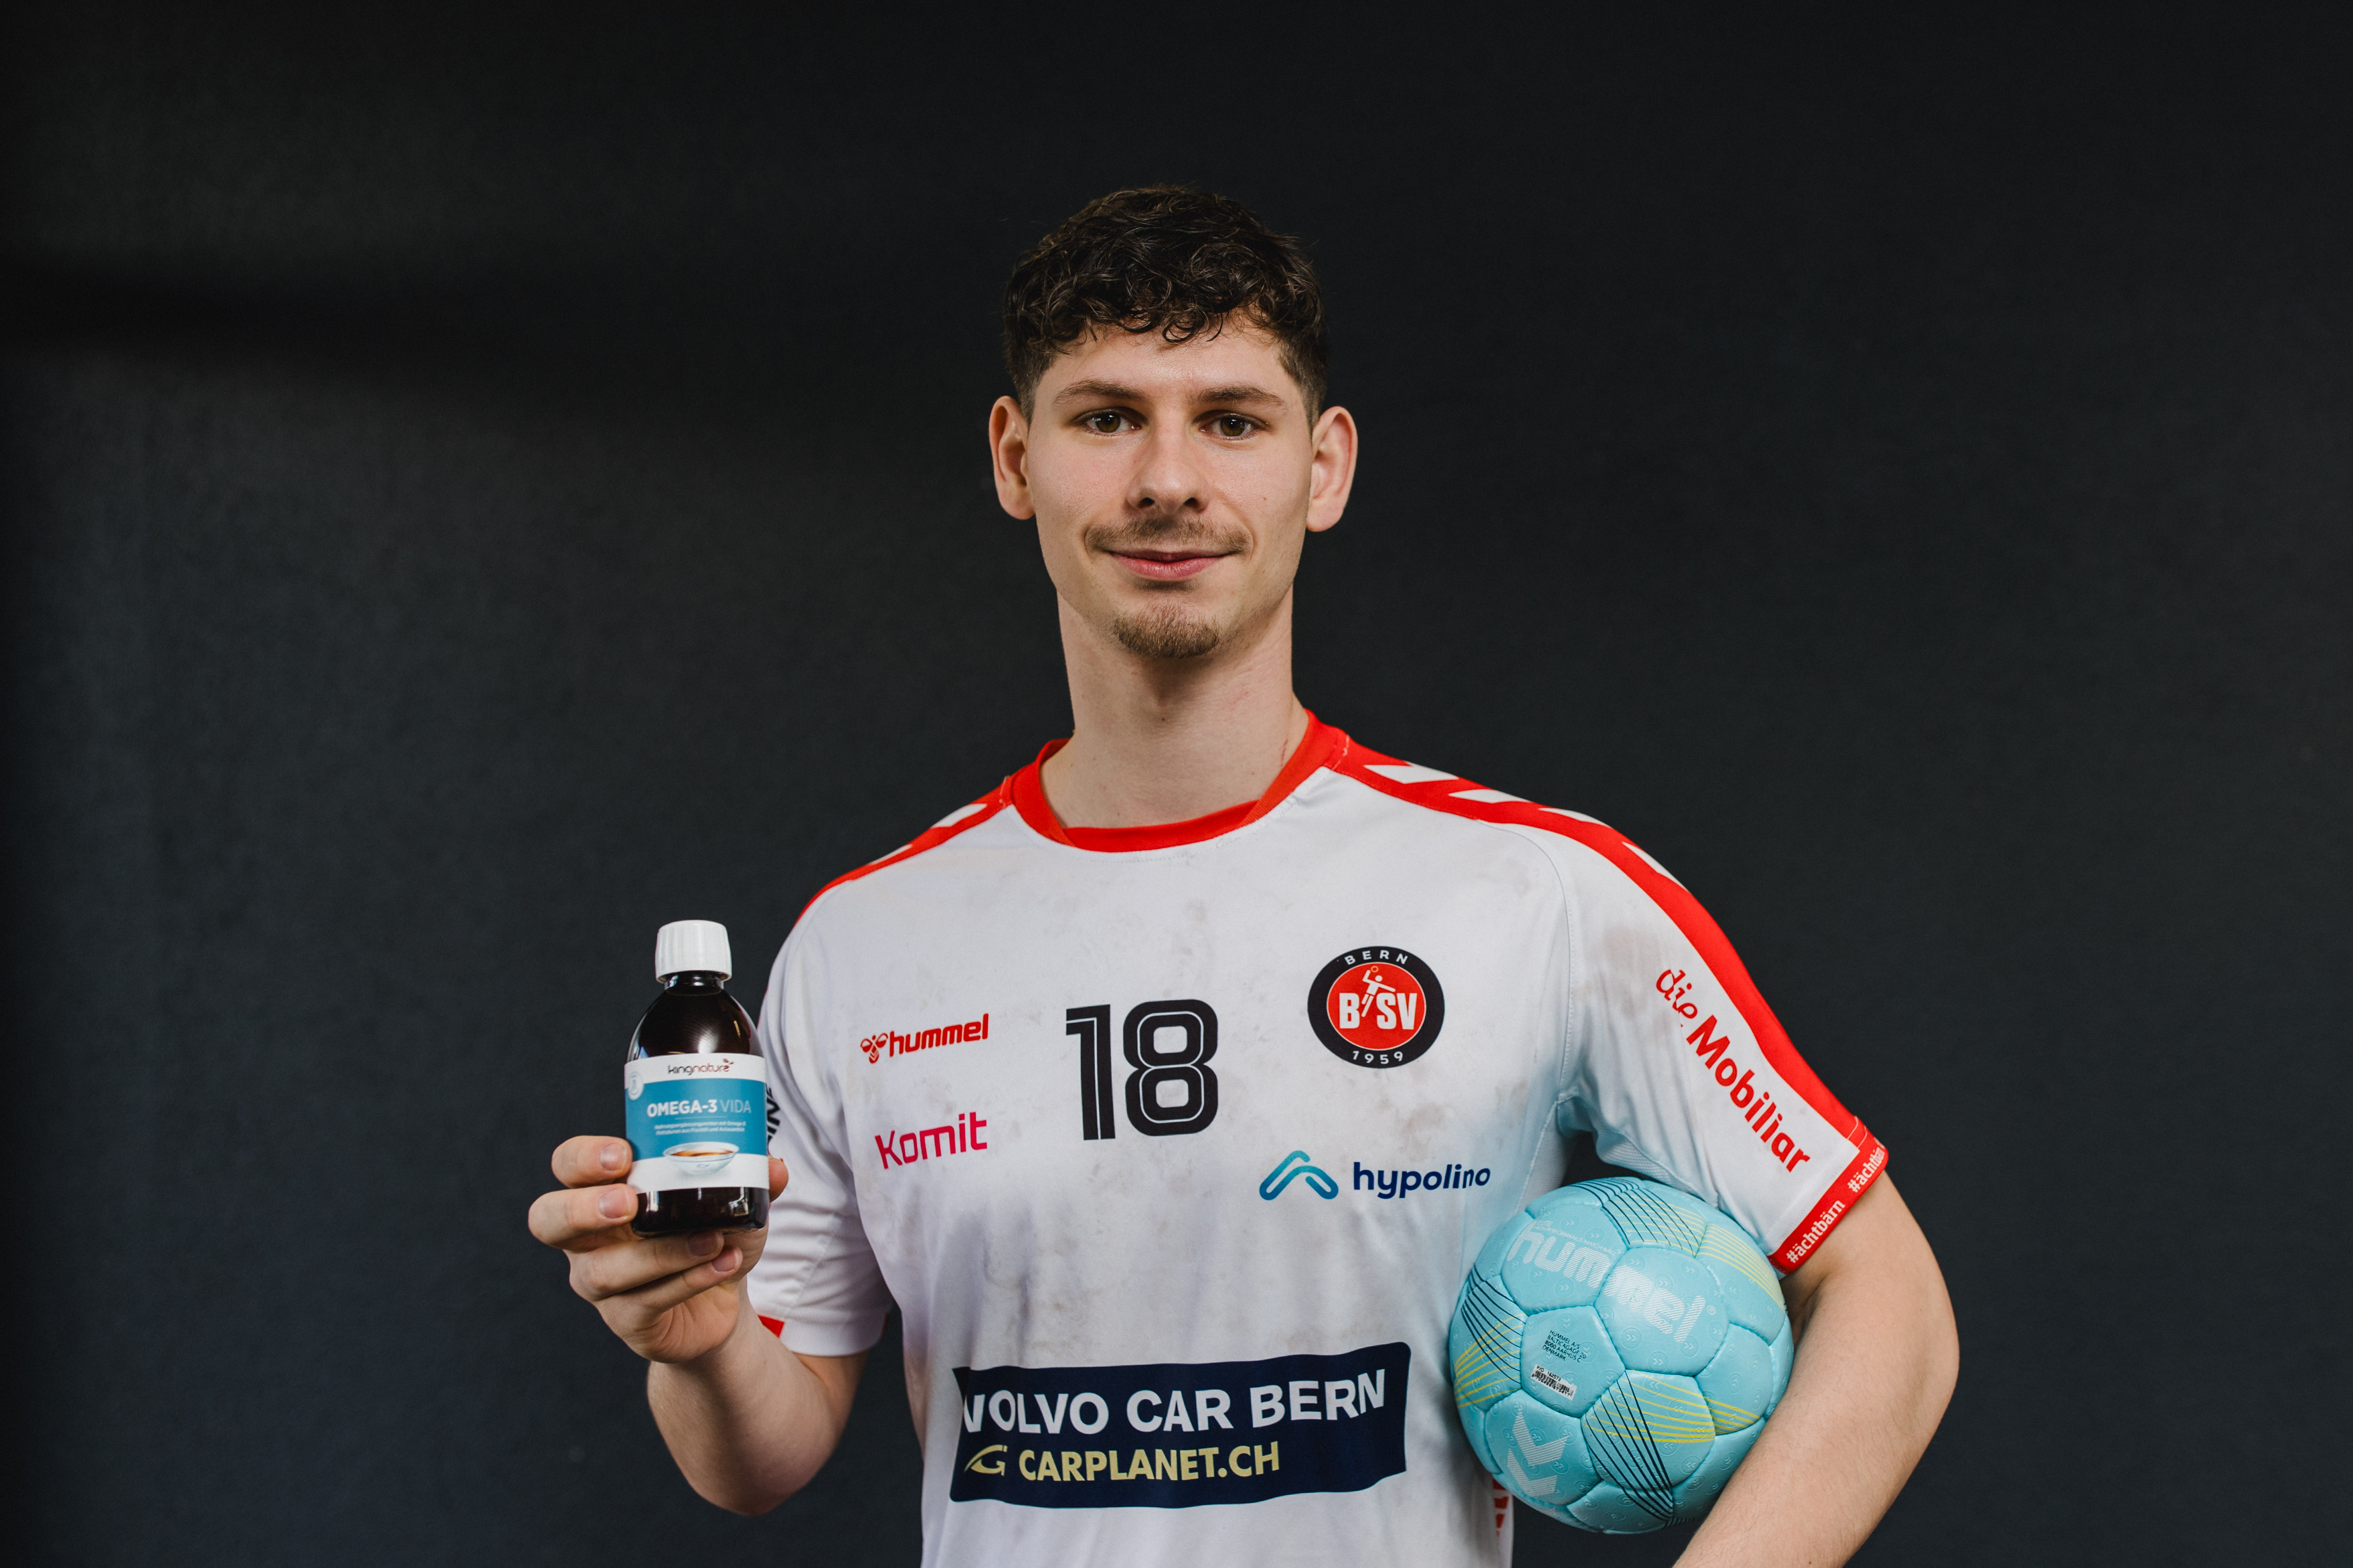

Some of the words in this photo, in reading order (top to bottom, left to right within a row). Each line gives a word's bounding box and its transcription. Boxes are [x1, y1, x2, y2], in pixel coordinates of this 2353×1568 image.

[1344, 950, 1408, 965] BERN
[1339, 993, 1417, 1030] BSV
[889, 1013, 989, 1057] hummel
[668, 1063, 730, 1075] kingnature
[1066, 999, 1219, 1140] 18
[1352, 1050, 1403, 1065] 1959
[1656, 969, 1698, 1027] die
[1686, 1014, 1810, 1173] Mobiliar
[647, 1099, 718, 1117] OMEGA-3
[720, 1099, 752, 1113] VIDA
[875, 1112, 987, 1169] Komit
[1353, 1161, 1491, 1199] hypolino
[1786, 1199, 1846, 1263] #ächtbärn
[1543, 1345, 1566, 1361] DENMARK
[1545, 1340, 1556, 1349] 8000
[1557, 1347, 1576, 1360] AARHUS
[1550, 1330, 1570, 1343] HUMMEL
[964, 1390, 1109, 1435] VOLVO
[1126, 1389, 1234, 1432] CAR
[1249, 1369, 1385, 1428] BERN
[1019, 1441, 1280, 1481] CARPLANET.CH
